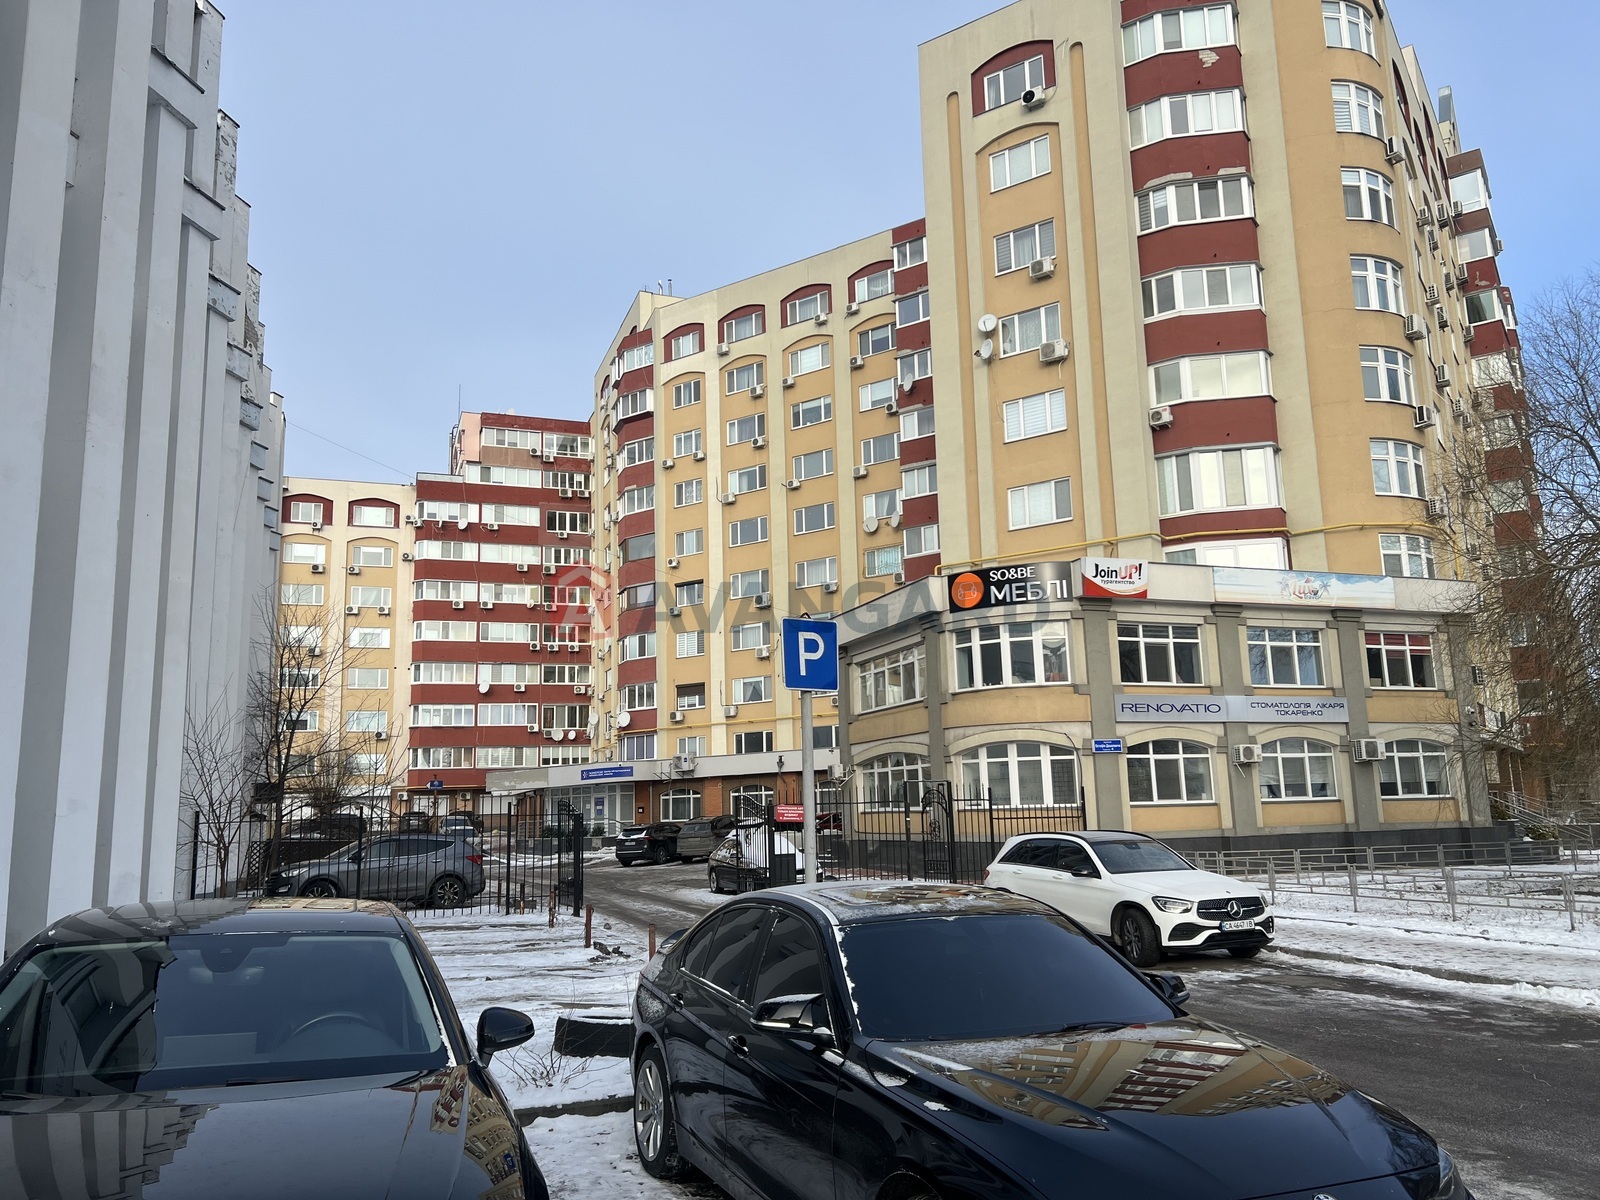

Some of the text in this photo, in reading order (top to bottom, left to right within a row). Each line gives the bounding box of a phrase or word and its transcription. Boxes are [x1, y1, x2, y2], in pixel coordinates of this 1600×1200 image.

[989, 566, 1036, 582] SO&BE
[990, 579, 1068, 604] МЕБЛІ
[798, 631, 824, 676] P
[1121, 703, 1222, 714] RENOVATIO
